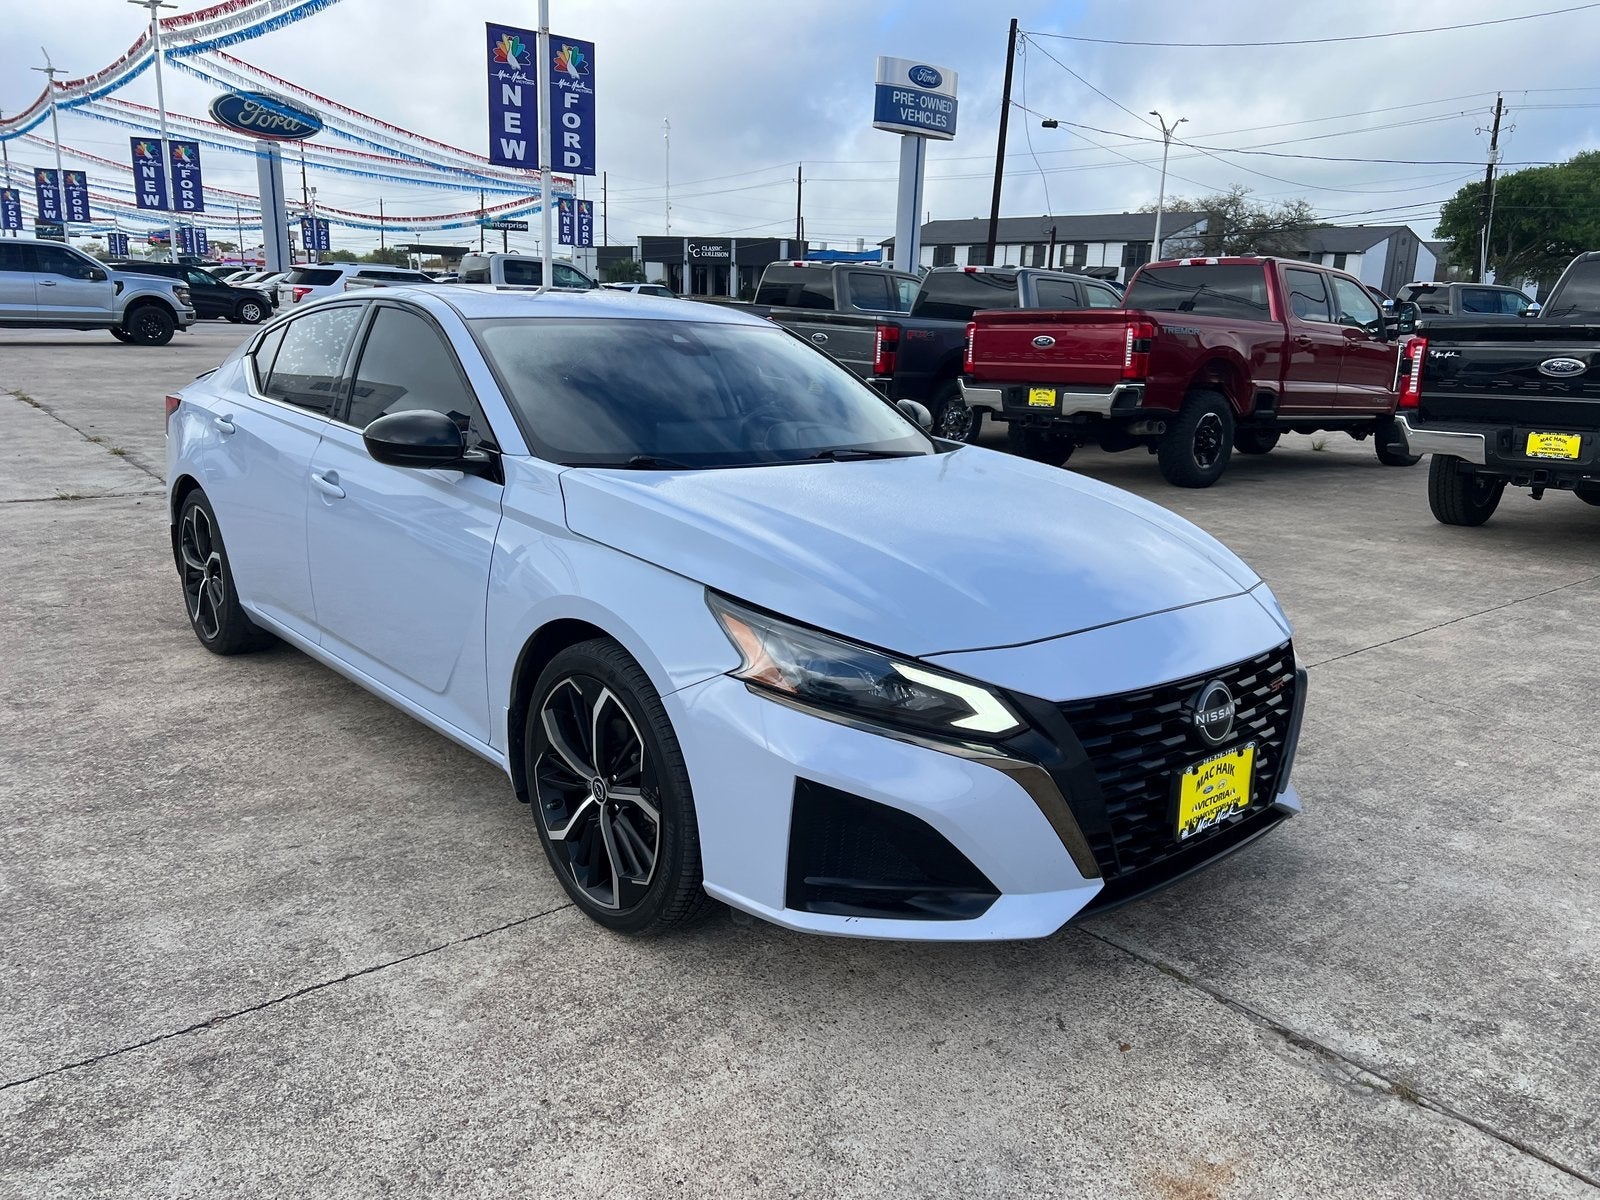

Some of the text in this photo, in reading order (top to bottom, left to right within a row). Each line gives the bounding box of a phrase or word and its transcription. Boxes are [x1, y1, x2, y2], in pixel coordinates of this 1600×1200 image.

[917, 69, 936, 83] Ford
[500, 84, 526, 161] NEW
[562, 92, 581, 168] FORD
[900, 107, 947, 127] VEHICLES
[142, 166, 160, 206] NEW
[180, 169, 195, 209] FORD
[8, 204, 18, 228] FORD
[43, 189, 56, 219] NEW
[72, 191, 84, 221] FORD
[489, 221, 528, 230] nterprise
[563, 217, 571, 243] NEW
[582, 219, 590, 245] FORD
[1162, 326, 1201, 335] TREMOR
[1195, 704, 1235, 725] NISSAN
[1196, 766, 1215, 792] MAC
[1215, 762, 1236, 777] HAIK
